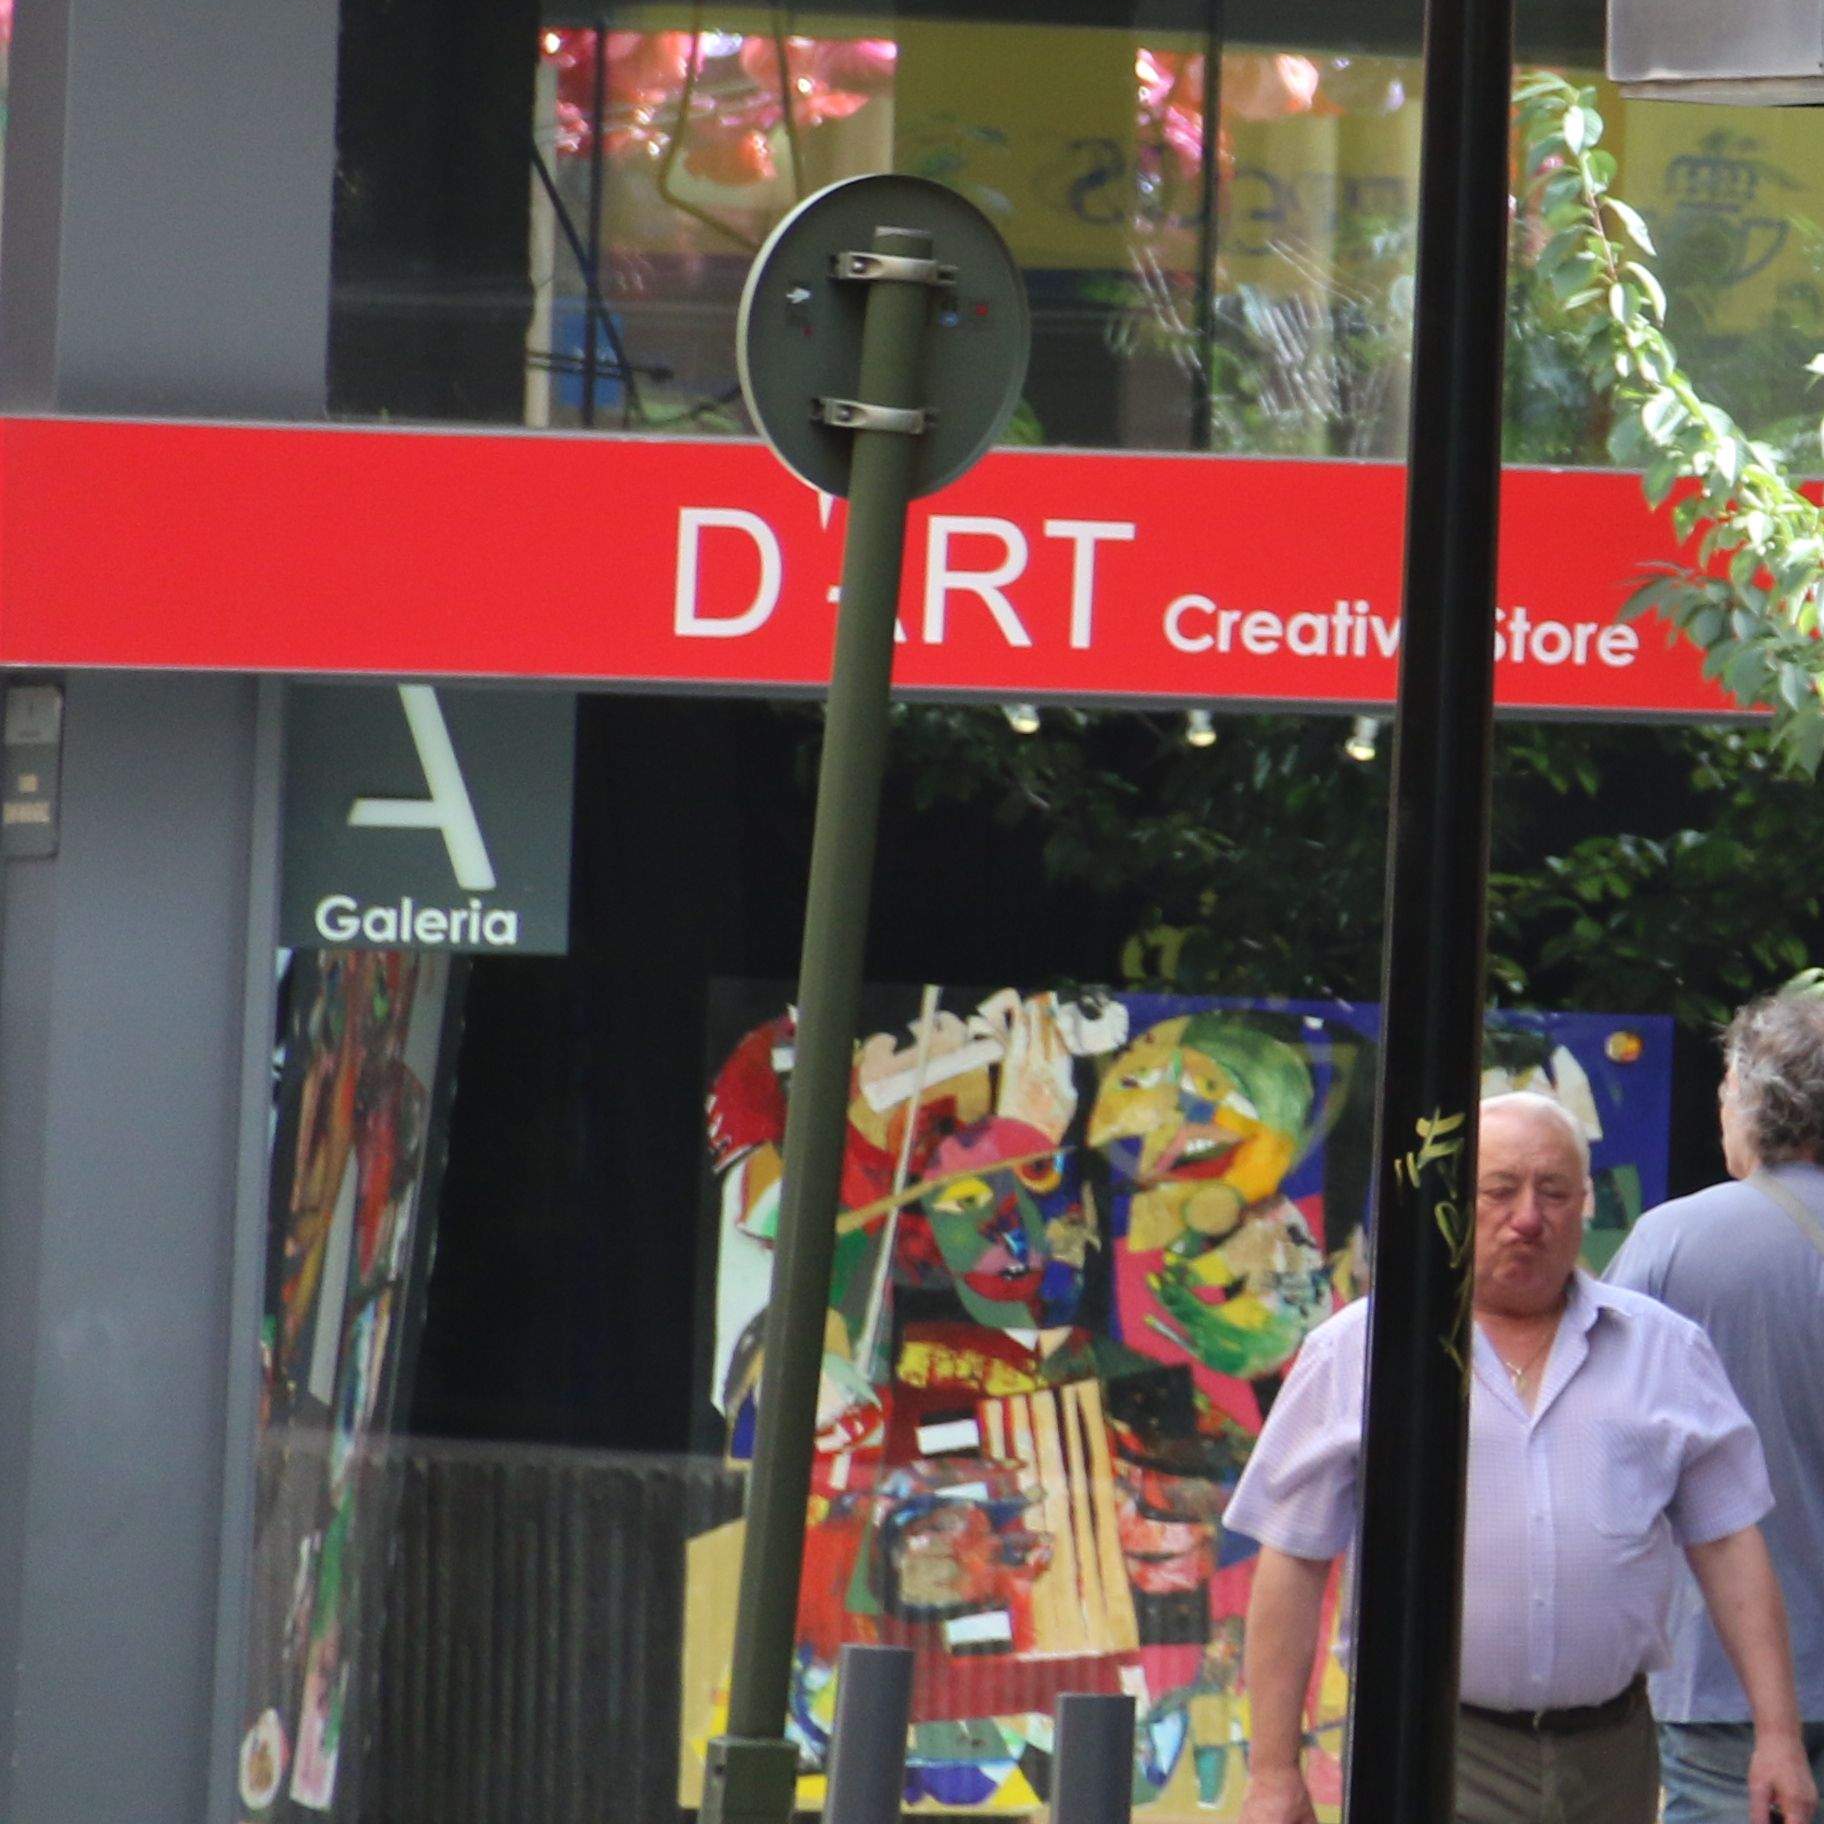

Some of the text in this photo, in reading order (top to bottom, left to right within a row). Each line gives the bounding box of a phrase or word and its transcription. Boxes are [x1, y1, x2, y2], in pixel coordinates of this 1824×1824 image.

[673, 492, 1136, 650] D'RT
[1163, 594, 1405, 659] Creativ
[314, 894, 518, 946] Galeria
